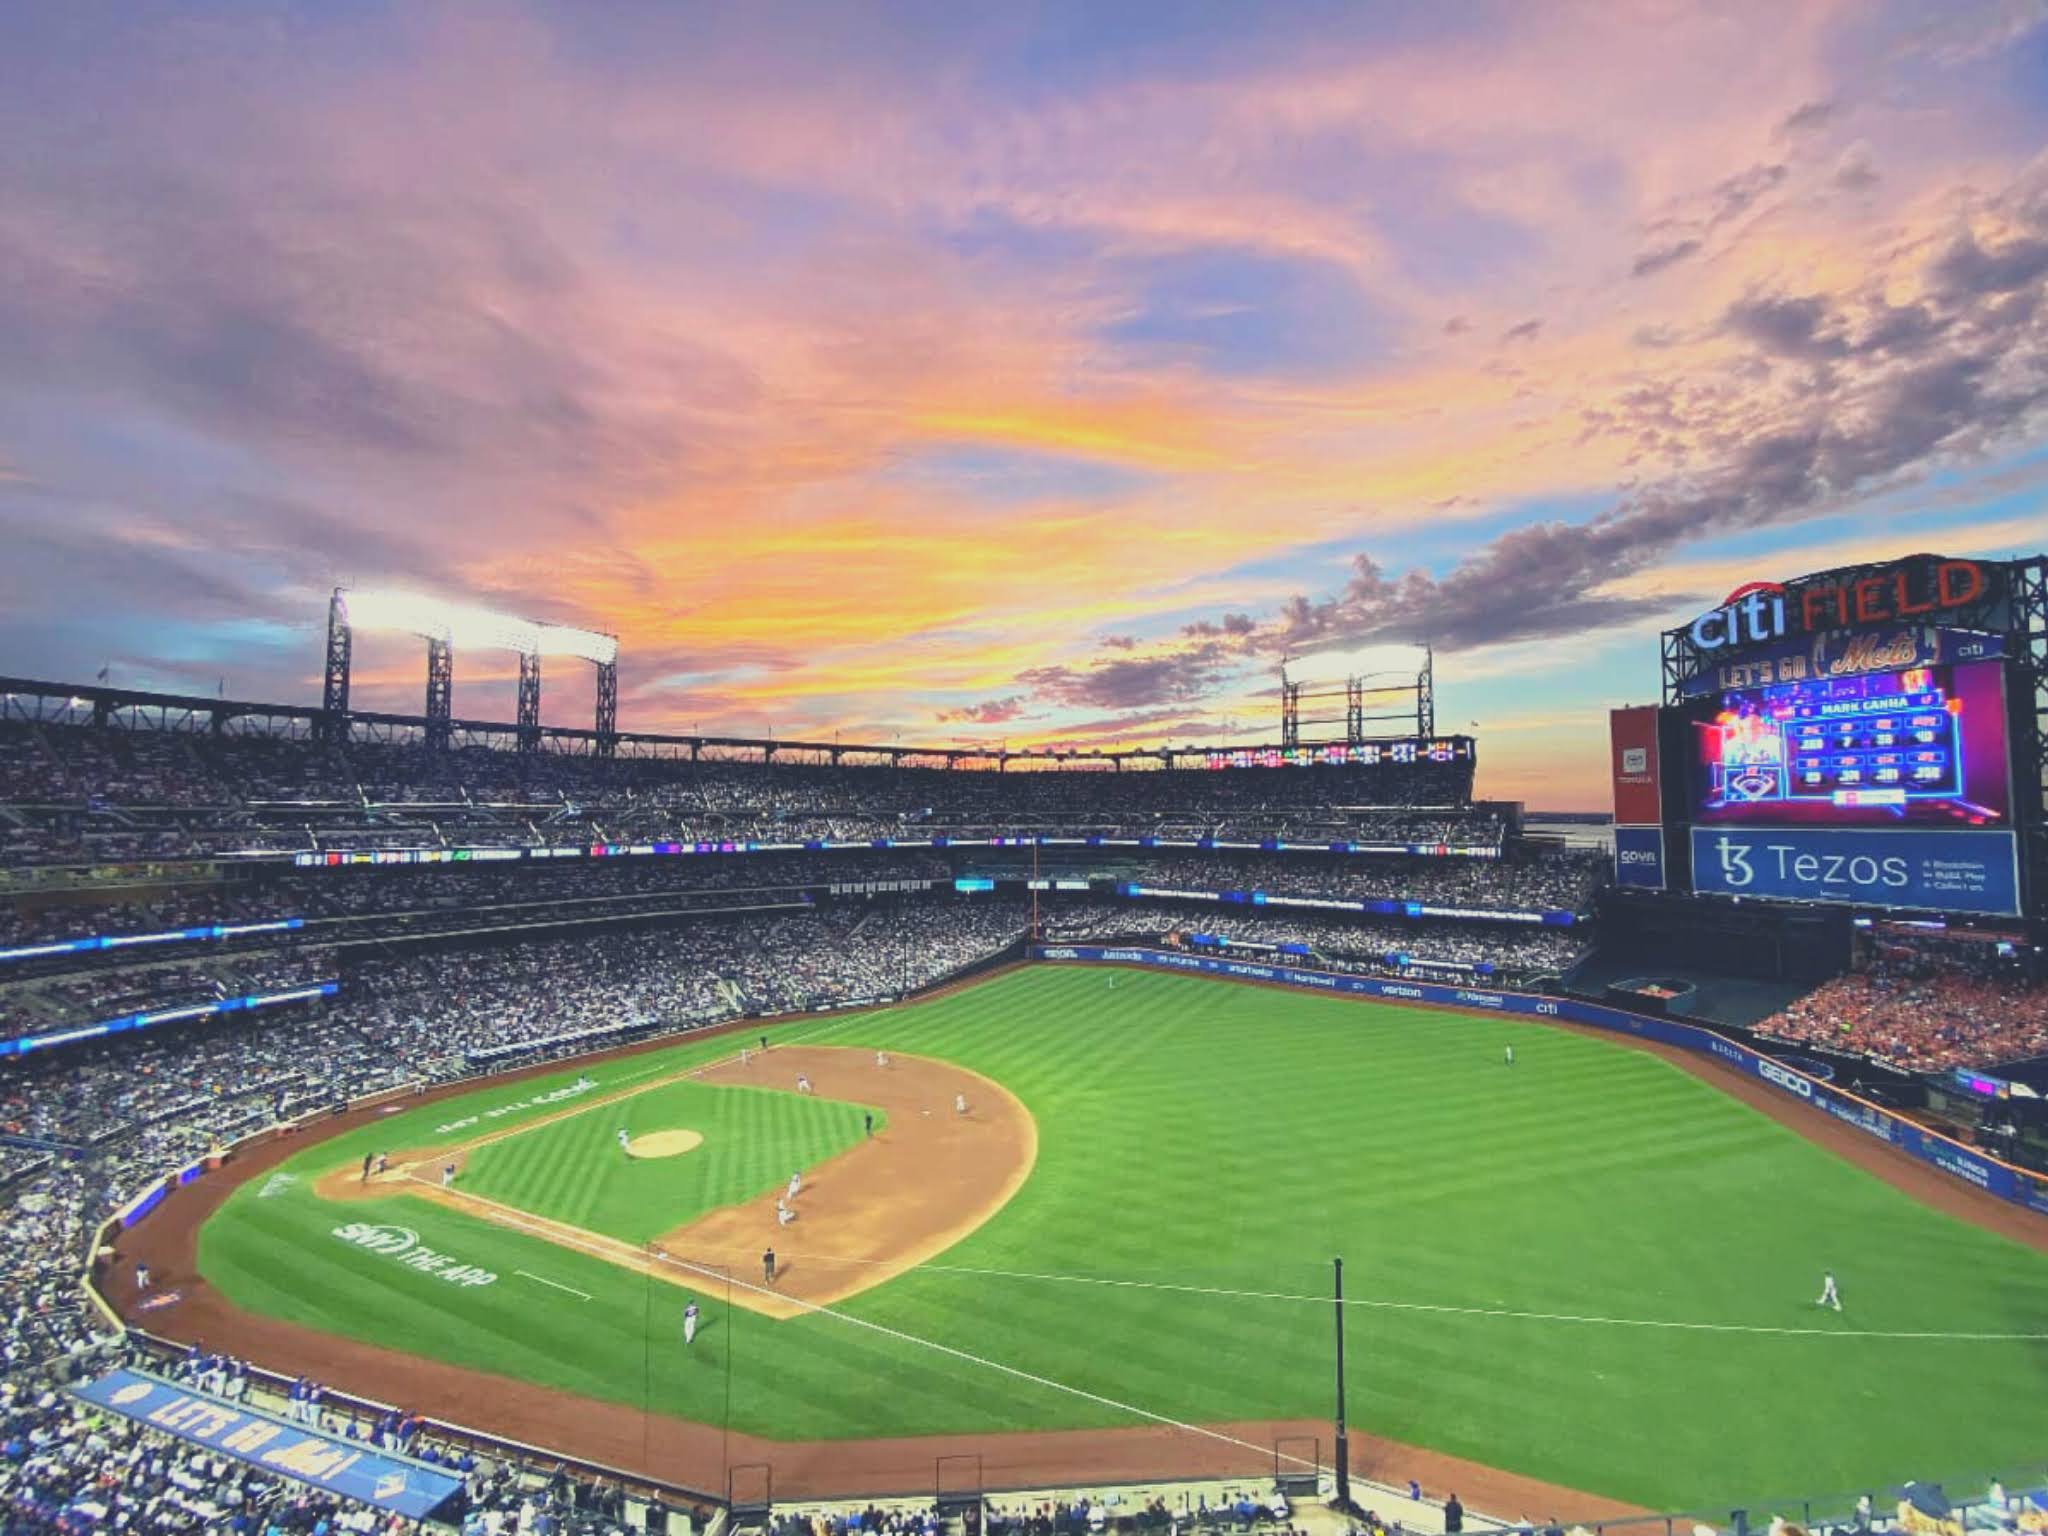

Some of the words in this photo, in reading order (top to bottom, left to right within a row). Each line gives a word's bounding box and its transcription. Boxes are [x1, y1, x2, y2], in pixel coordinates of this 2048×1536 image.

[1691, 593, 1785, 648] citi
[1802, 562, 1982, 631] FIELD
[1718, 661, 1773, 689] LET'S
[1779, 655, 1807, 682] GO
[1830, 631, 1918, 674] Mets
[1958, 644, 1984, 657] citi
[1621, 851, 1656, 863] GOYA
[1767, 845, 1909, 886] Tezos
[1535, 1002, 1558, 1015] citi
[1758, 1060, 1811, 1097] GEICO
[397, 1246, 456, 1272] THE
[435, 1264, 498, 1287] APP
[148, 1396, 241, 1437] LET'S
